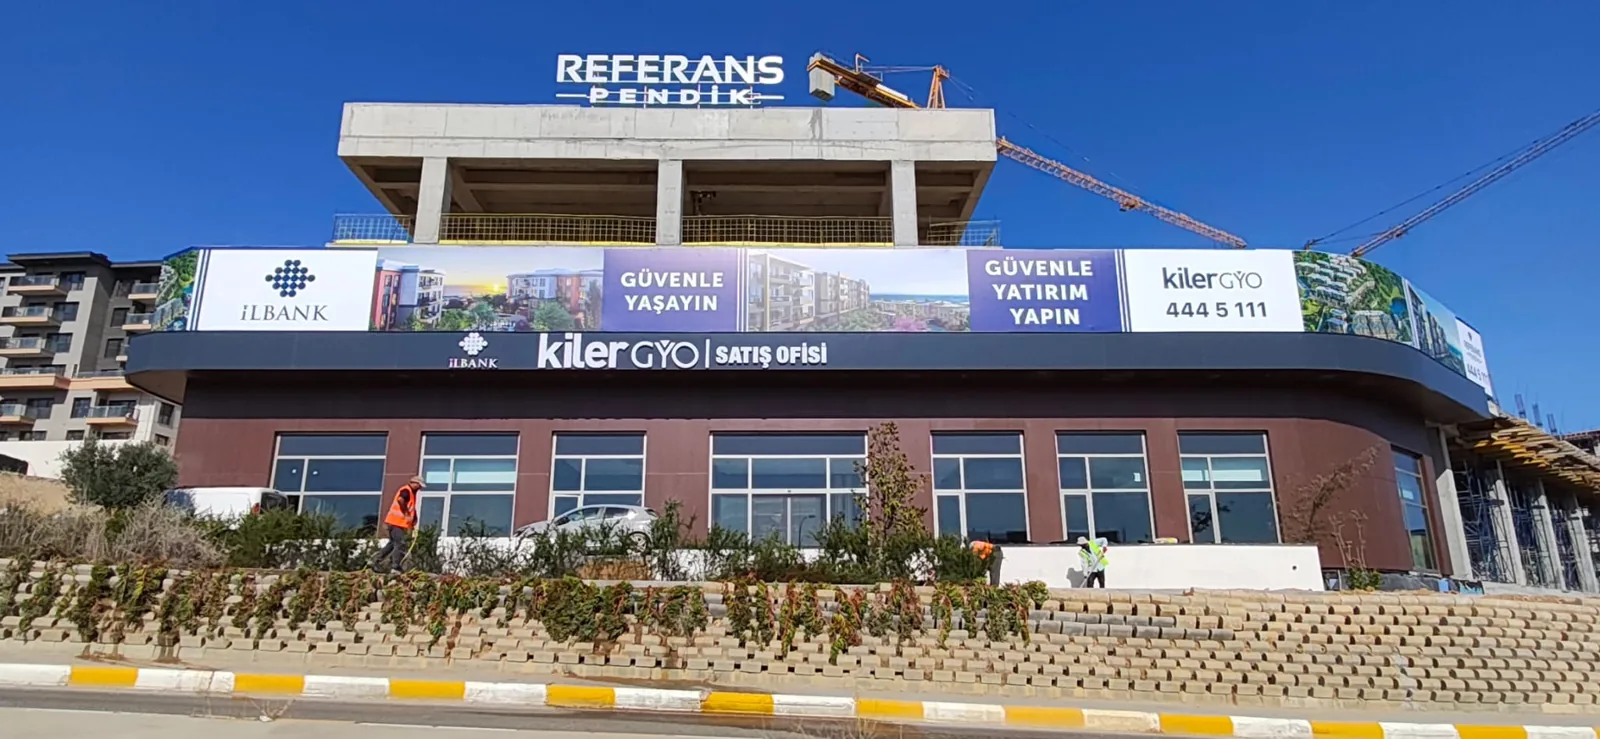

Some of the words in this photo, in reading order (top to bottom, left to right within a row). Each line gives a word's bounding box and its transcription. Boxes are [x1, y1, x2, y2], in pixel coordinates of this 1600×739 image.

[556, 54, 784, 84] REFERANS
[590, 85, 754, 104] PENDİK
[985, 257, 1093, 276] GÜVENLE
[620, 268, 724, 288] GÜVENLE
[992, 284, 1088, 301] YATIRIM
[624, 294, 718, 315] YAŞAYIN
[1166, 302, 1209, 317] 444
[1216, 302, 1228, 317] 5
[1234, 302, 1267, 317] 111
[1010, 308, 1080, 325] YAPIN
[715, 346, 772, 369] SATIŞ
[776, 342, 828, 364] OFİSİ
